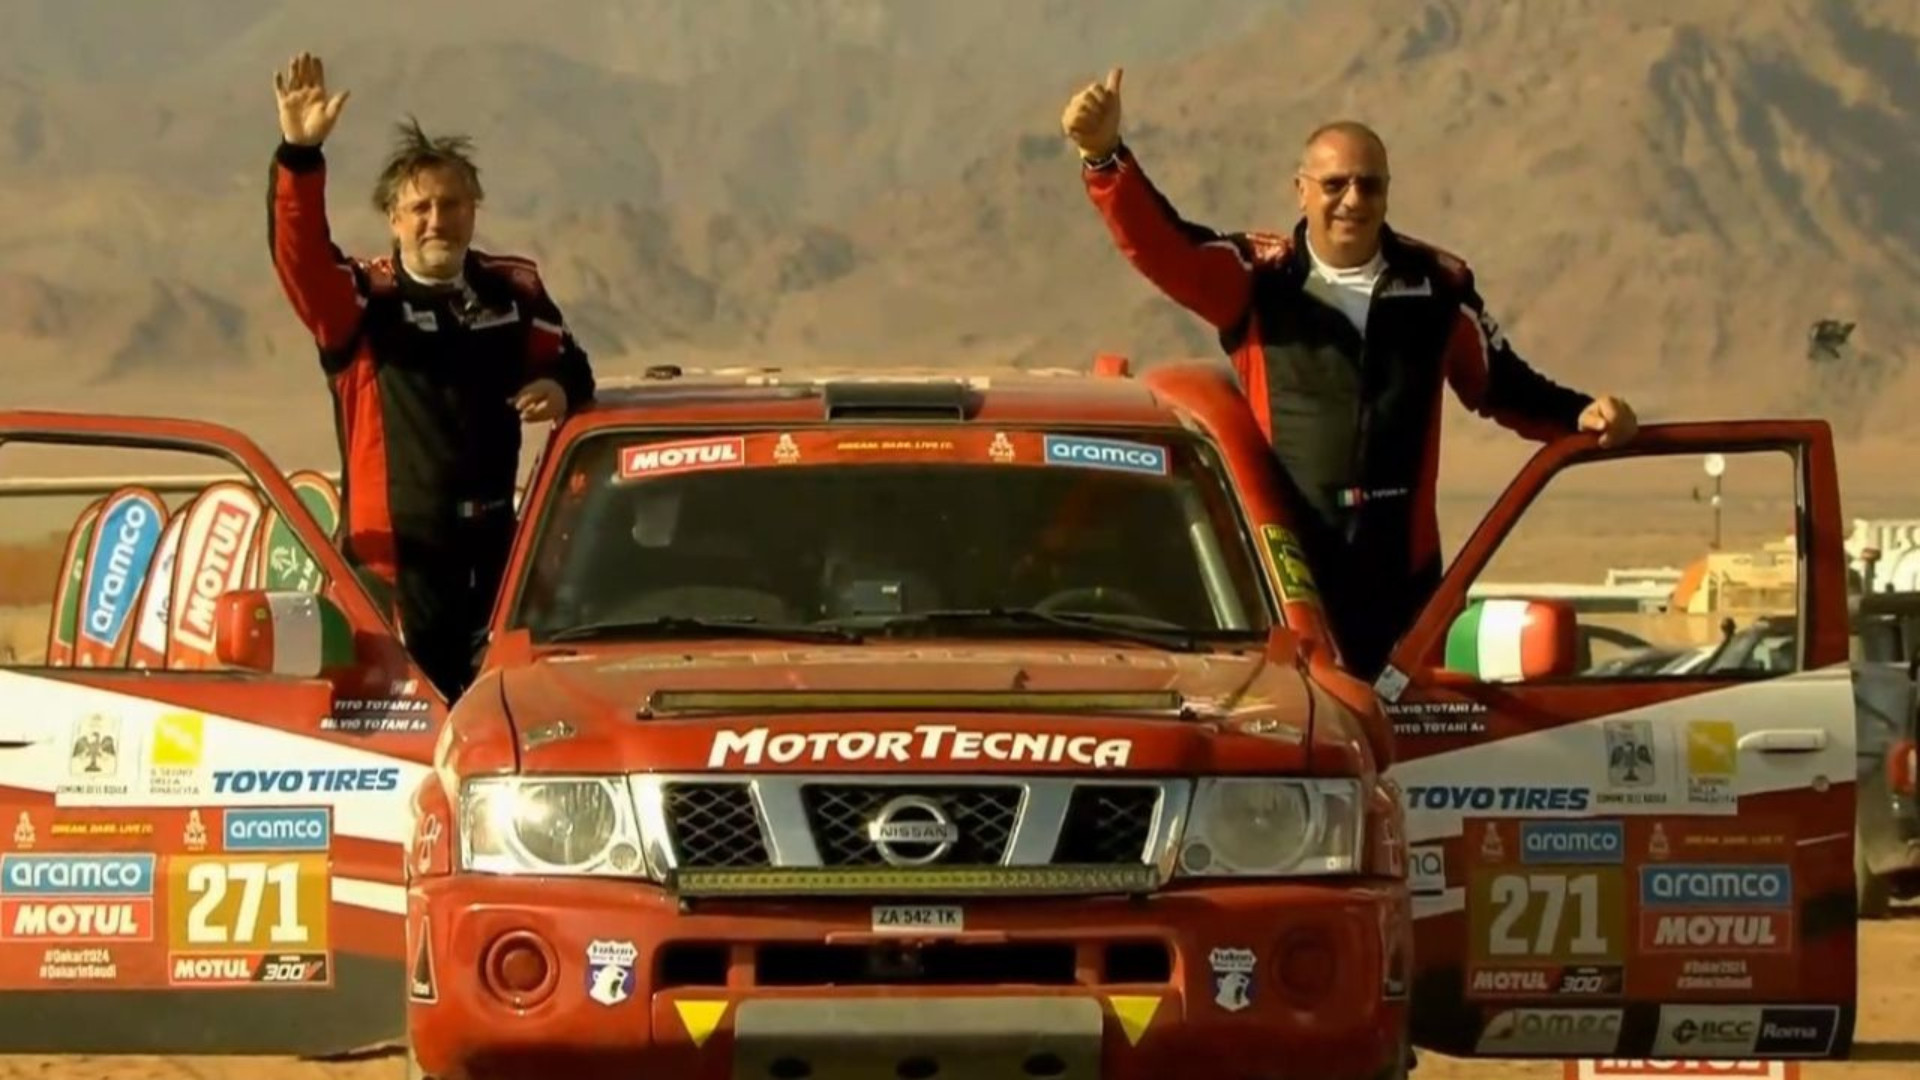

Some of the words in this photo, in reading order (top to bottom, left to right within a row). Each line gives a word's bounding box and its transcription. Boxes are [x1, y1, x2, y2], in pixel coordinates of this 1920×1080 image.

[631, 443, 738, 470] MOTUL
[1052, 441, 1159, 468] aramco
[92, 505, 146, 632] aramco
[188, 512, 244, 634] MOTUL
[212, 771, 304, 793] TOYO
[306, 768, 399, 792] TIRES
[1407, 786, 1495, 810] TOYO
[1499, 787, 1589, 811] TIRES
[231, 820, 322, 839] aramco
[880, 826, 947, 837] NISSAN
[1526, 832, 1617, 851] aramco
[11, 862, 142, 887] aramco
[1652, 873, 1780, 897] aramco
[187, 862, 309, 943] 271
[1489, 873, 1608, 955] 271
[13, 904, 139, 935] MOTUL
[878, 909, 900, 925] ZA
[904, 909, 932, 925] 542
[938, 909, 957, 924] TK
[1654, 915, 1777, 945] MOTUL
[174, 959, 251, 979] MOTUL
[1473, 970, 1549, 990] MOTUL
[1702, 1020, 1754, 1036] BCC
[1763, 1022, 1818, 1039] Roma
